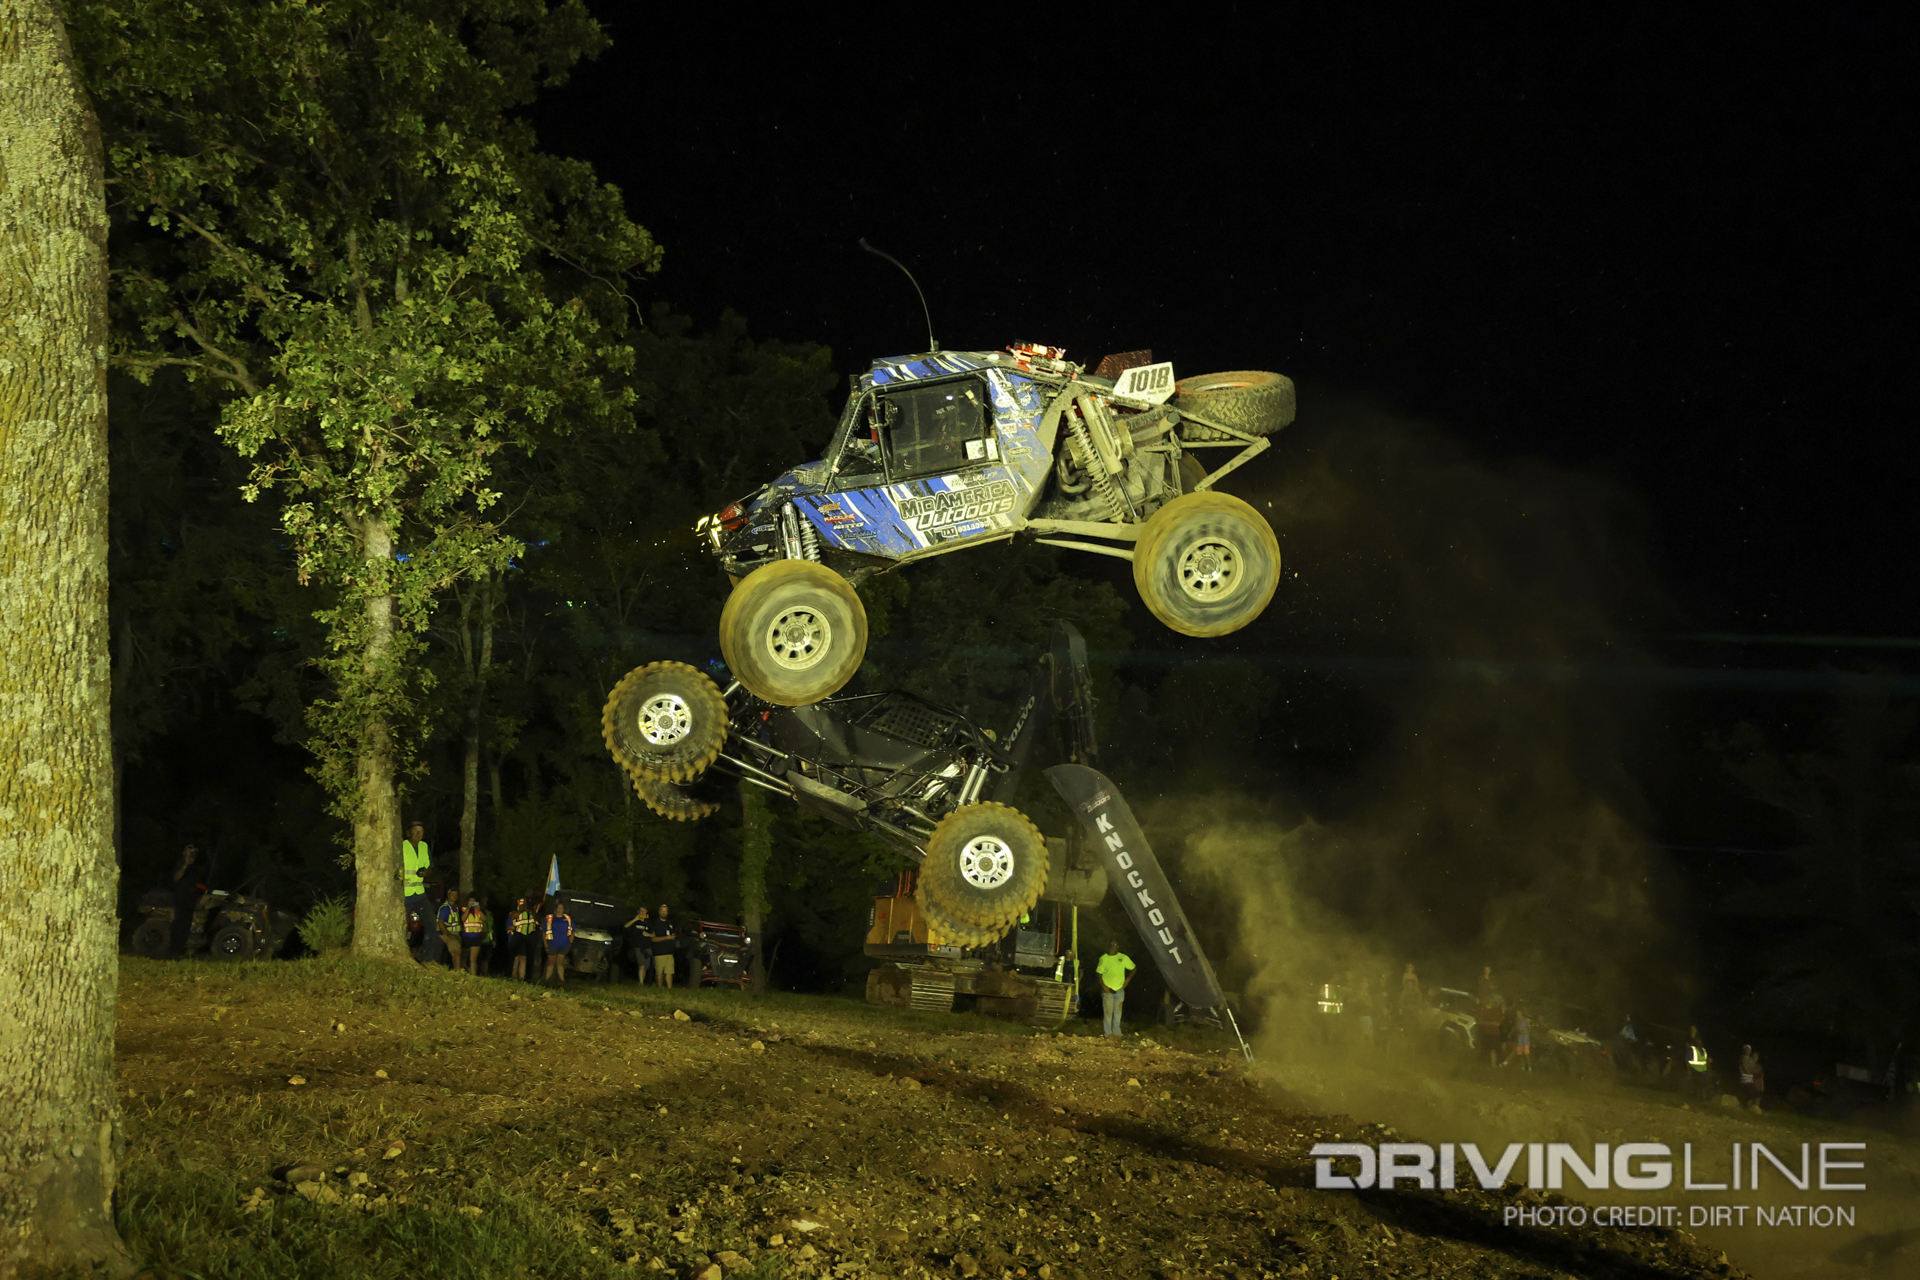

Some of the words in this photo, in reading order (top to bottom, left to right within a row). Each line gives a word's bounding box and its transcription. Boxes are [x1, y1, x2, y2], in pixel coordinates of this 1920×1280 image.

[1129, 366, 1170, 393] 1018
[833, 521, 865, 530] NITTO
[1004, 696, 1035, 751] VOLVO
[1095, 813, 1183, 965] KNOCKOUT
